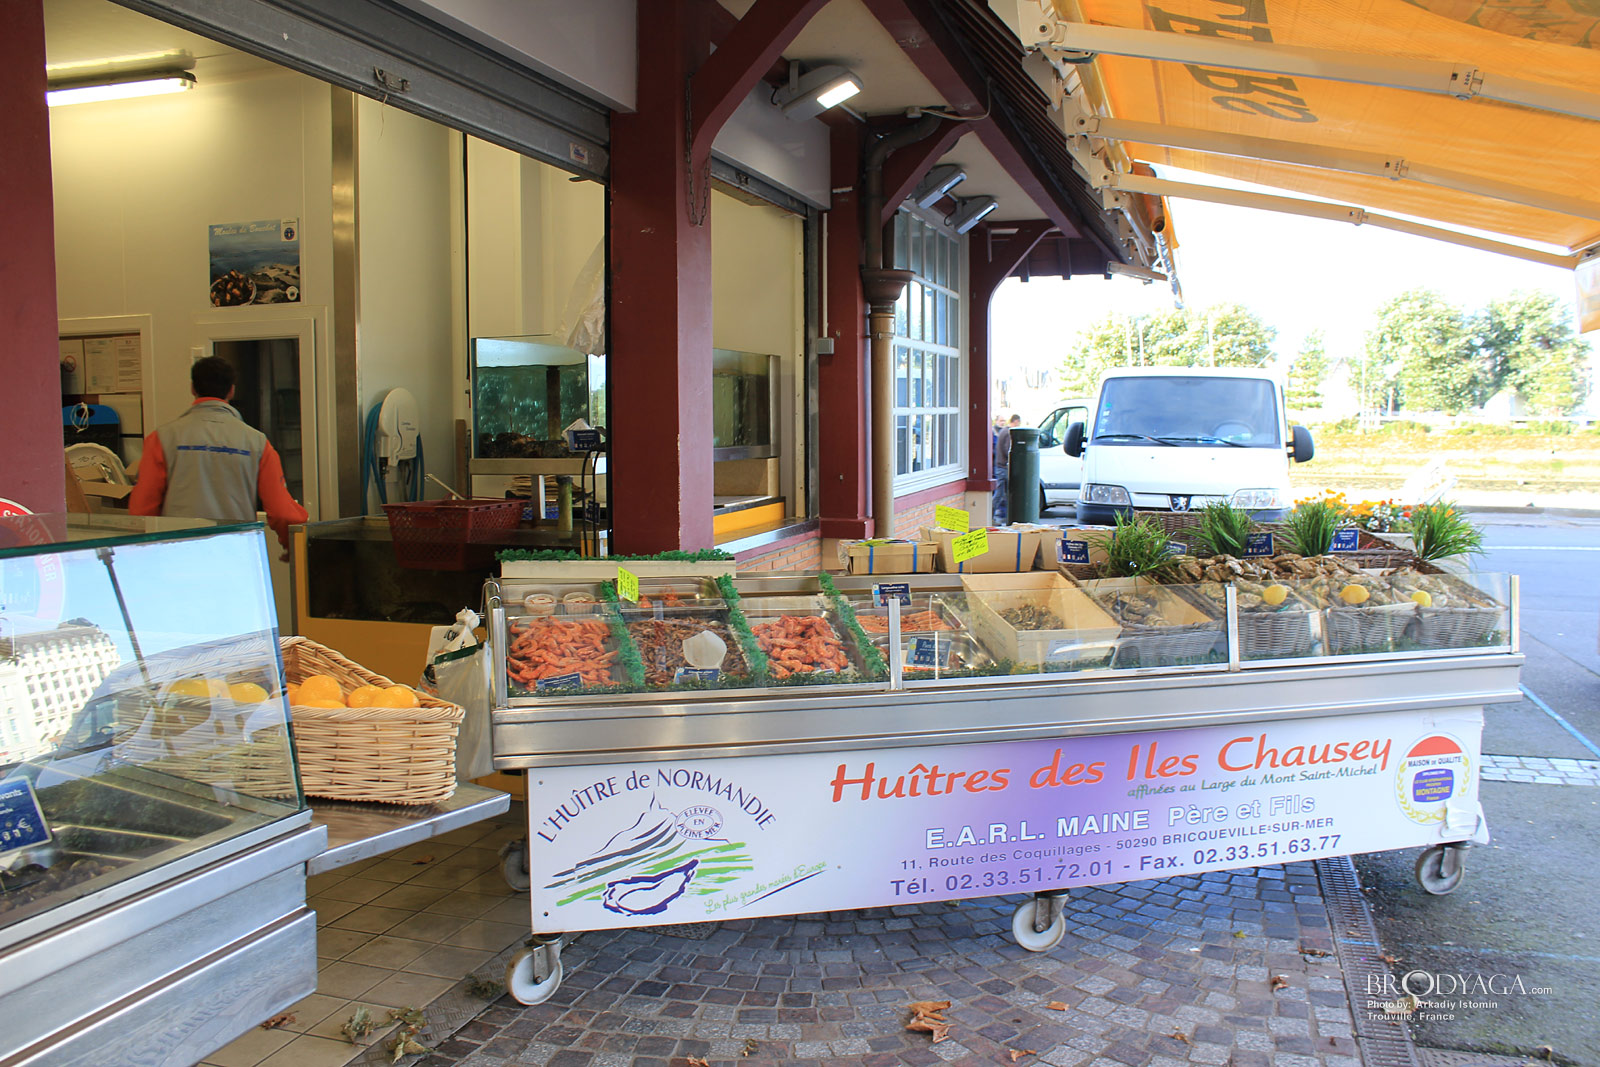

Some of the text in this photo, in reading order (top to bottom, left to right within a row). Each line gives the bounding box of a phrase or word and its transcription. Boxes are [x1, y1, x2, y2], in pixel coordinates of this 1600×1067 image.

[830, 733, 1392, 803] Huîtres des Iles Chausey
[1127, 764, 1379, 800] affinées au Large du Mont Saint-Michel
[1408, 759, 1430, 767] MAISON
[536, 768, 777, 844] L'HUÎTRE de NORMANDIE
[678, 822, 721, 839] PLEINE MER
[693, 818, 706, 826] EN
[926, 794, 1315, 850] E.A.R.L. MAINE Père et Fils
[891, 877, 935, 896] Tél.
[945, 860, 1113, 891] 02.33.51.72.01
[1140, 855, 1185, 871] Fax.
[1193, 834, 1341, 865] 02.33.51.63.77
[901, 859, 922, 870] 11,
[929, 855, 974, 868] Route
[980, 852, 1007, 863] des
[1013, 842, 1101, 860] Coquillages
[1116, 836, 1157, 850] 50290
[1162, 817, 1334, 845] BRICQUEVILLE-SUR-MER
[722, 893, 738, 912] plus
[740, 884, 767, 905] grandes
[768, 873, 792, 889] marées
[793, 860, 827, 879] d'Europe
